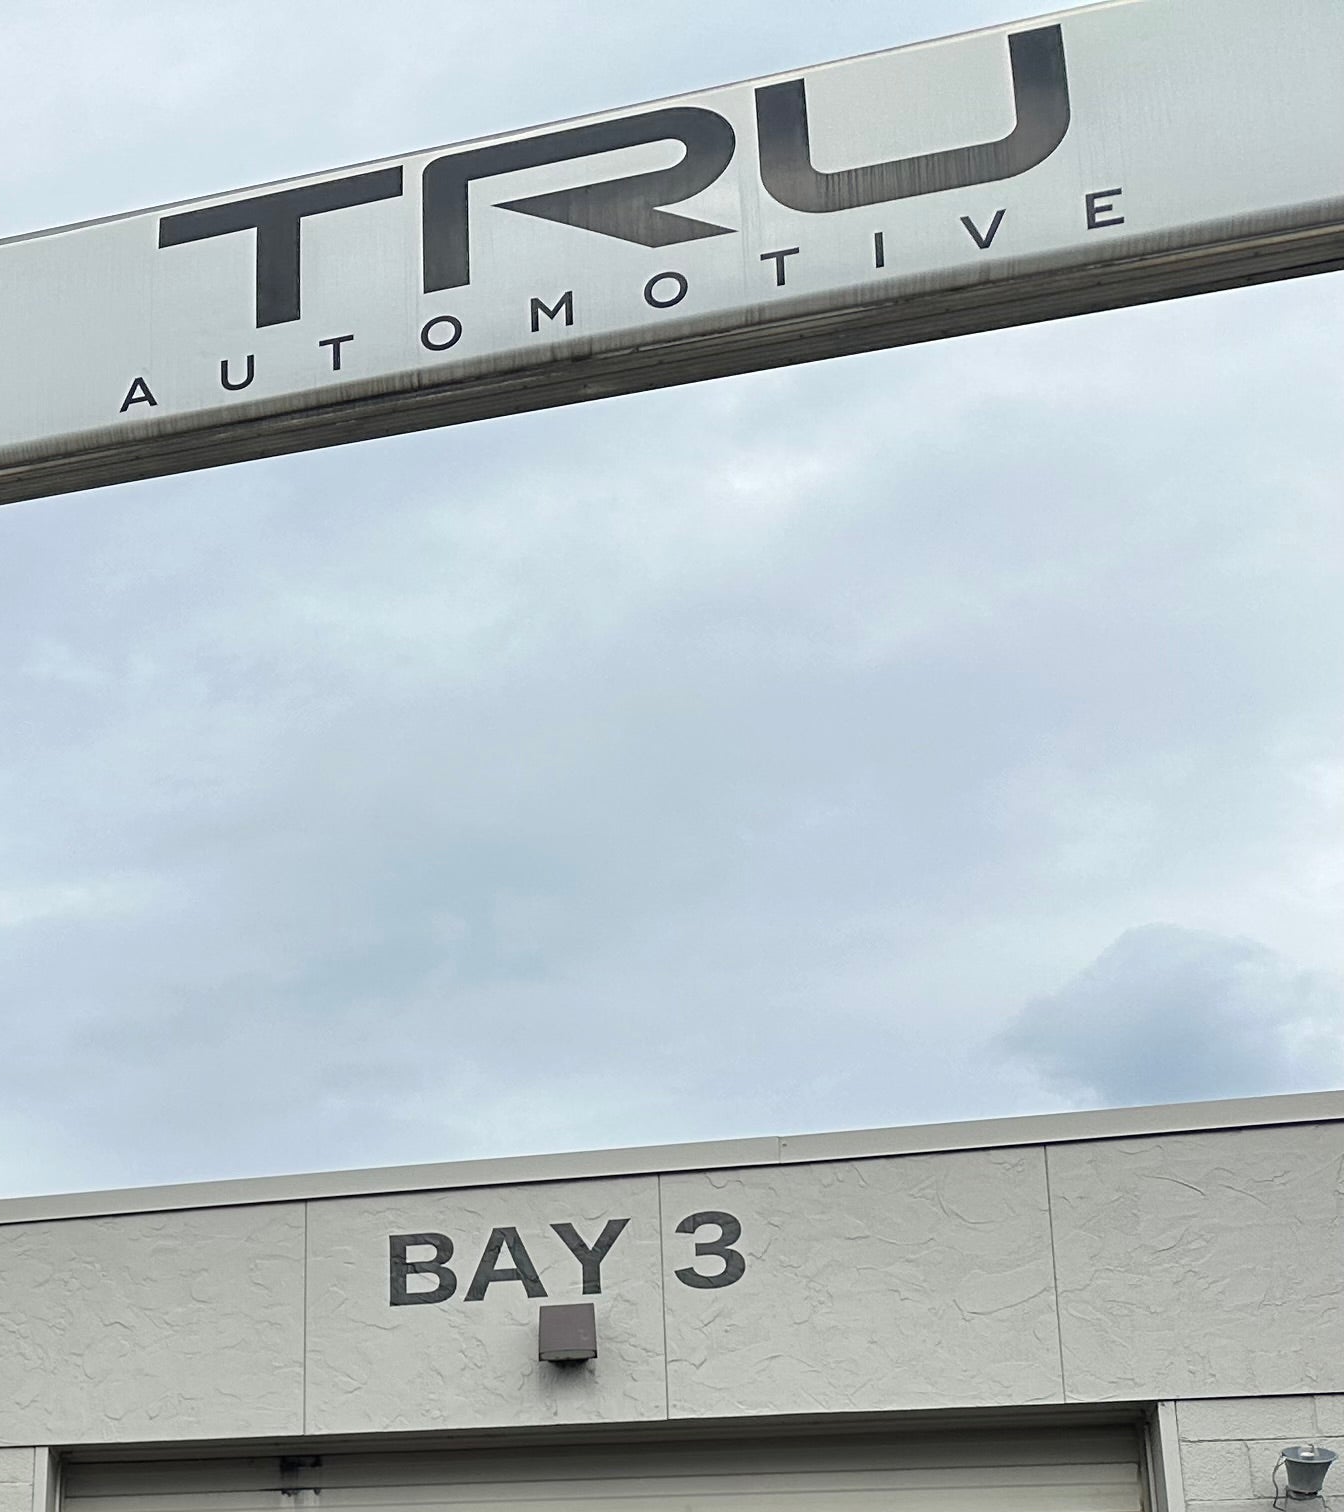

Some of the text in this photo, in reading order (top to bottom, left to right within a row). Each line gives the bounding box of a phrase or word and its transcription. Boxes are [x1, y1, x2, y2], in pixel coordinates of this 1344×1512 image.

[158, 23, 1071, 329] TRU
[119, 187, 1125, 413] AUTOMOTIVE
[388, 1210, 746, 1307] BAY 3
